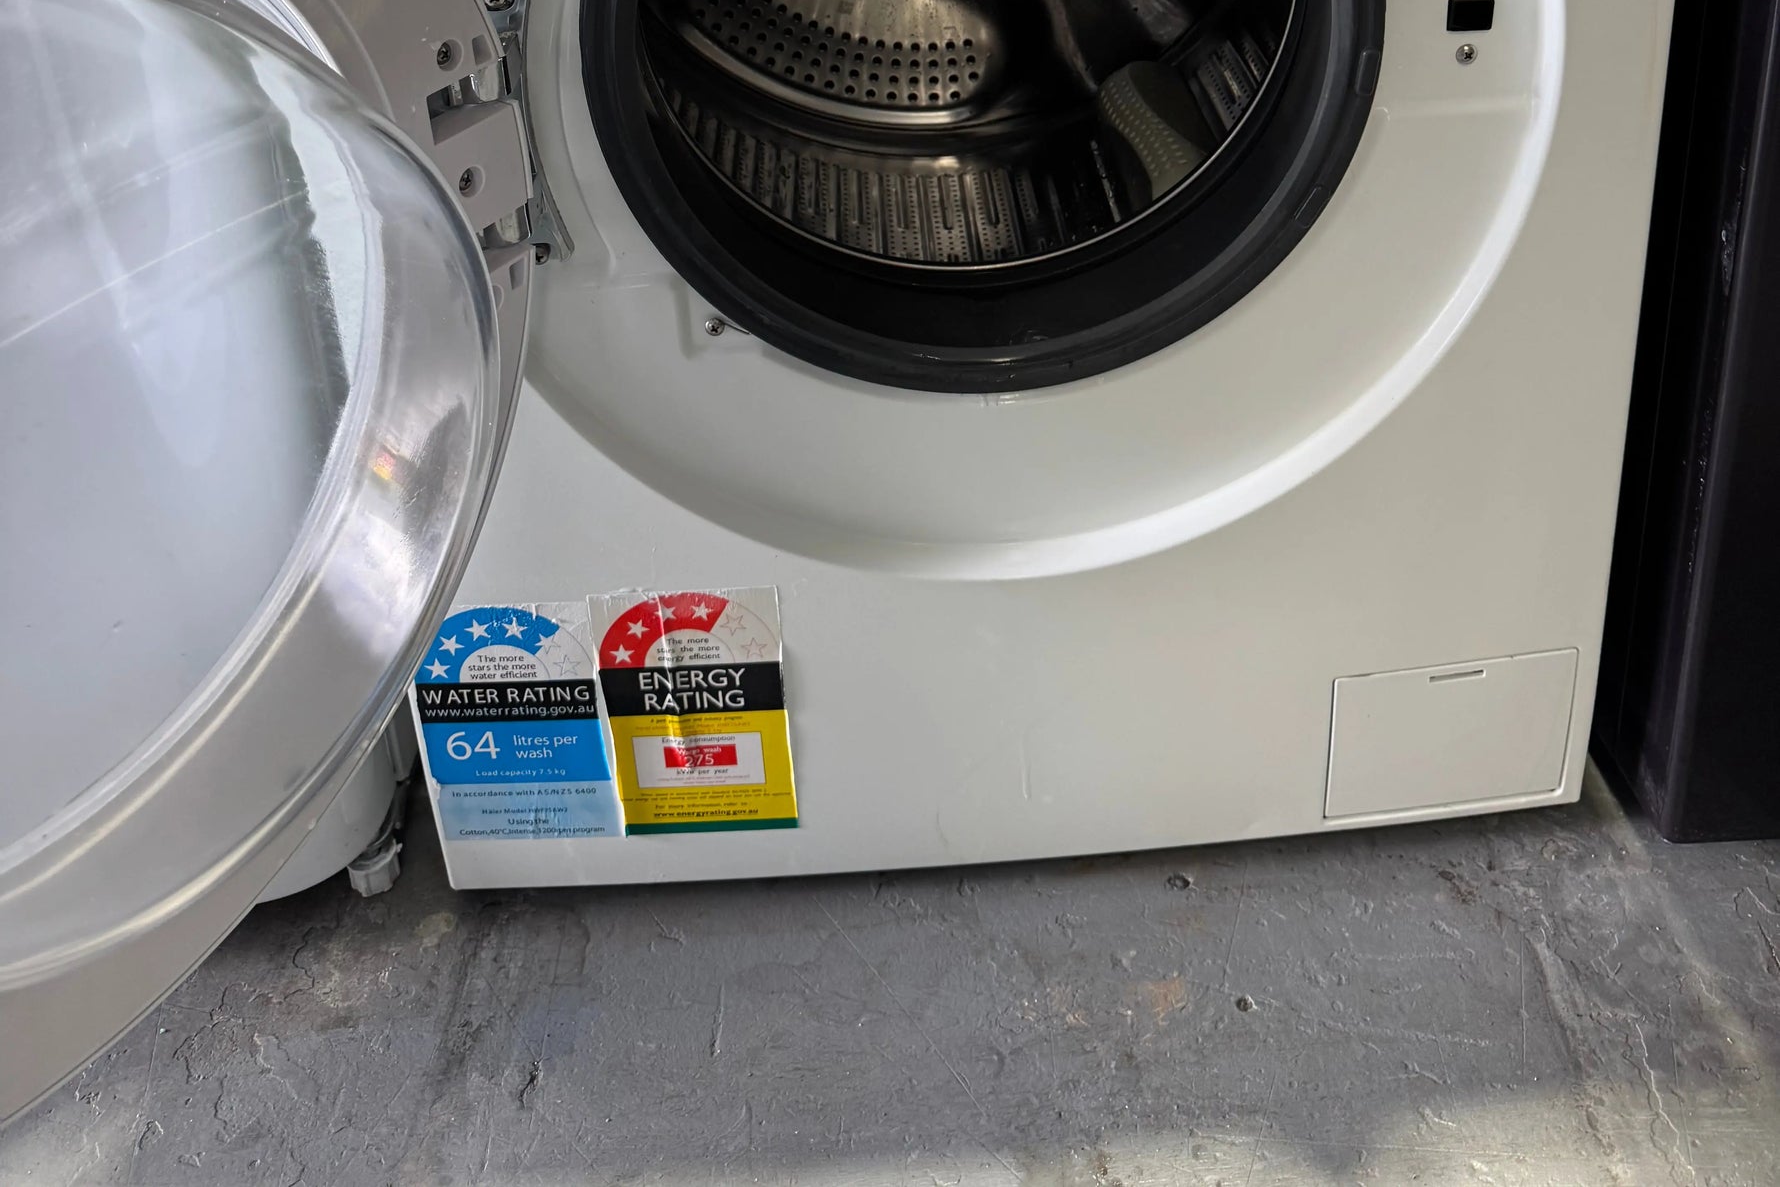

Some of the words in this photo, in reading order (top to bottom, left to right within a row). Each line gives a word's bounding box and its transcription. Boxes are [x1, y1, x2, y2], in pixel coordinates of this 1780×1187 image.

[667, 637, 683, 645] The
[477, 654, 497, 663] The
[468, 664, 492, 672] stars
[494, 663, 510, 671] the
[500, 670, 538, 679] efficient
[638, 667, 747, 692] ENERGY
[422, 687, 500, 706] WATER
[507, 685, 590, 704] RATING
[643, 689, 746, 713] RATING
[424, 703, 595, 718] www.waterrating.gov.au
[513, 734, 550, 747] litres
[553, 735, 578, 748] per
[688, 735, 736, 744] consumption
[446, 730, 501, 762] 64
[515, 746, 553, 759] wash
[684, 753, 715, 768] 275
[500, 769, 537, 777] capacity
[539, 768, 552, 776] 7.5
[554, 768, 566, 776] kg
[698, 768, 710, 776] per
[714, 767, 729, 775] year
[452, 790, 462, 798] In
[463, 789, 513, 798] accordance
[515, 788, 535, 797] with
[575, 787, 597, 795] 6400
[508, 818, 533, 827] Using
[573, 826, 606, 835] program
